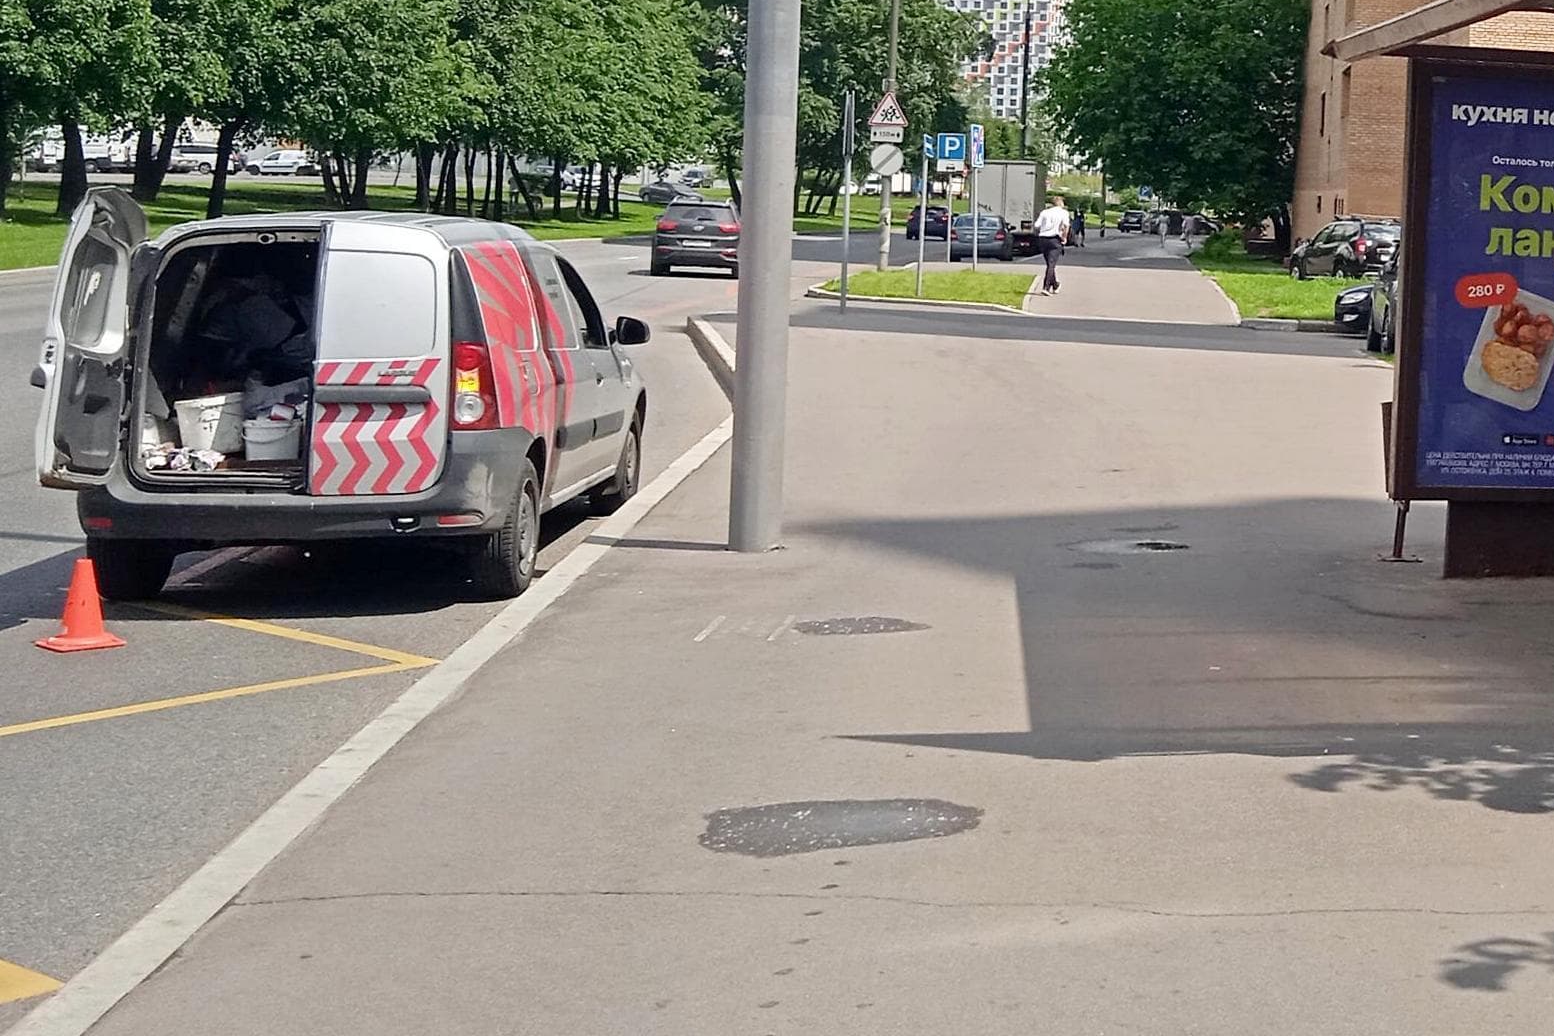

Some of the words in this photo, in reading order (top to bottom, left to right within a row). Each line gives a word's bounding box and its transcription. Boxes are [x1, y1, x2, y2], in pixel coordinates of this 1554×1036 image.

[1452, 103, 1528, 126] кухня
[1492, 155, 1538, 167] Осталось
[1467, 284, 1492, 298] 280
